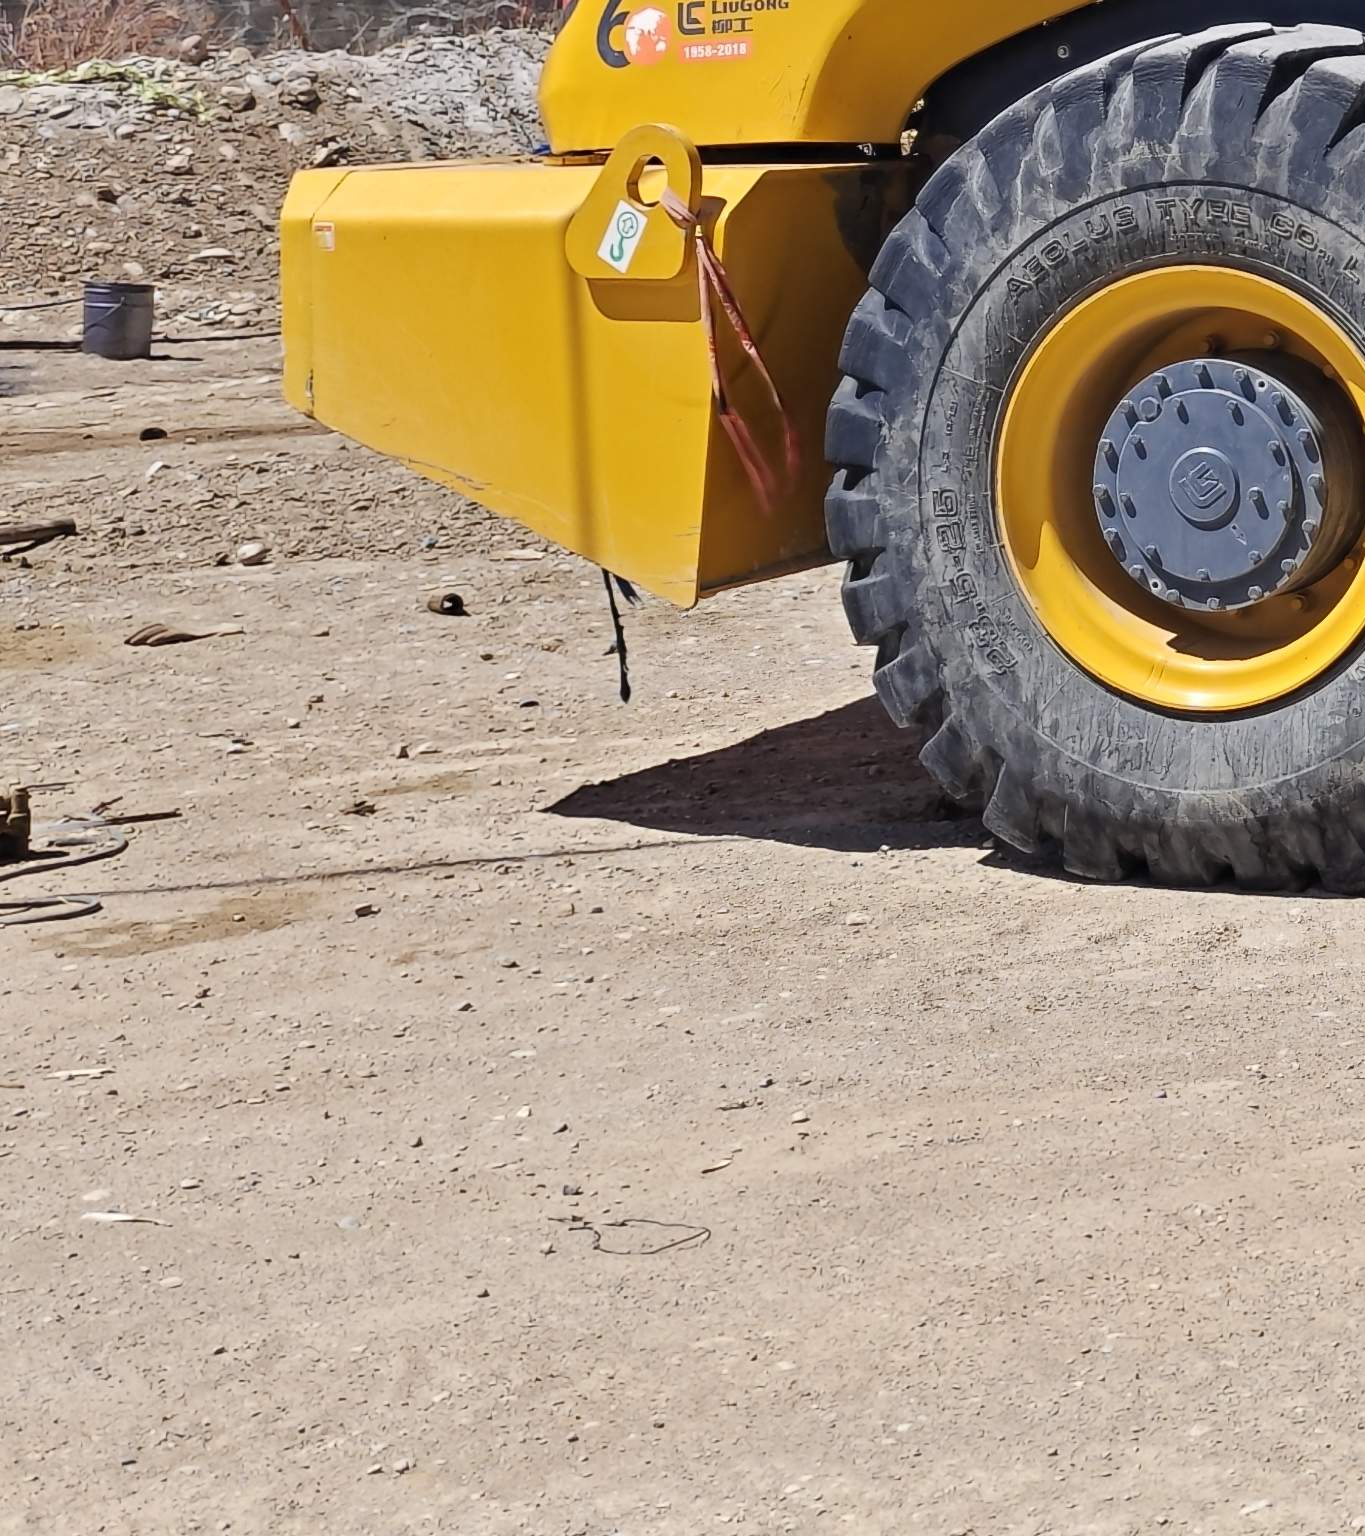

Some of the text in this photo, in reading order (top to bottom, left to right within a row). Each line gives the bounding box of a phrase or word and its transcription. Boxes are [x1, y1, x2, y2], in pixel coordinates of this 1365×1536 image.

[712, 17, 754, 35] 柳工
[683, 42, 747, 59] 1958-2018
[1005, 205, 1138, 302] AEOLUS
